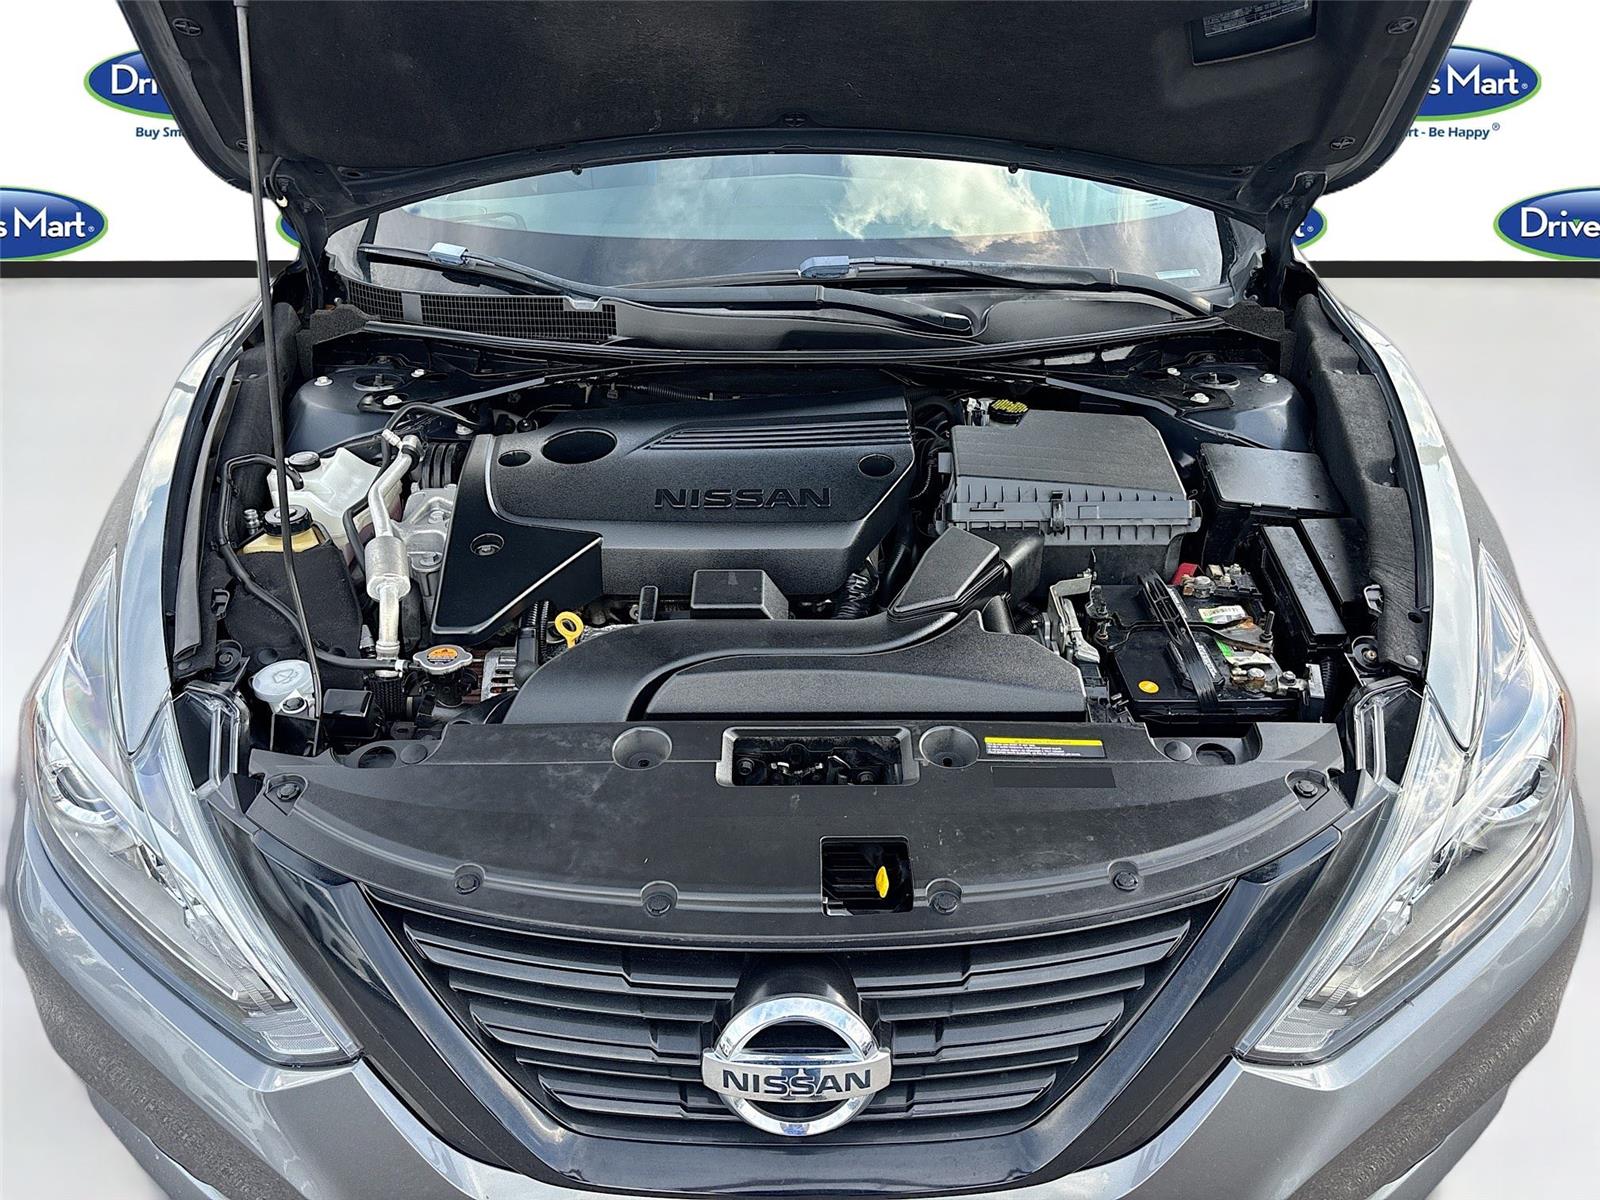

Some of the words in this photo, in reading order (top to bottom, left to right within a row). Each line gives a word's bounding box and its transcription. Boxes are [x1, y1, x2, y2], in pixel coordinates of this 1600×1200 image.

[136, 127, 160, 140] Buy
[1428, 127, 1445, 137] Be
[1448, 127, 1490, 140] Happy
[654, 487, 832, 509] NISSAN
[722, 1068, 871, 1096] NISSAN
